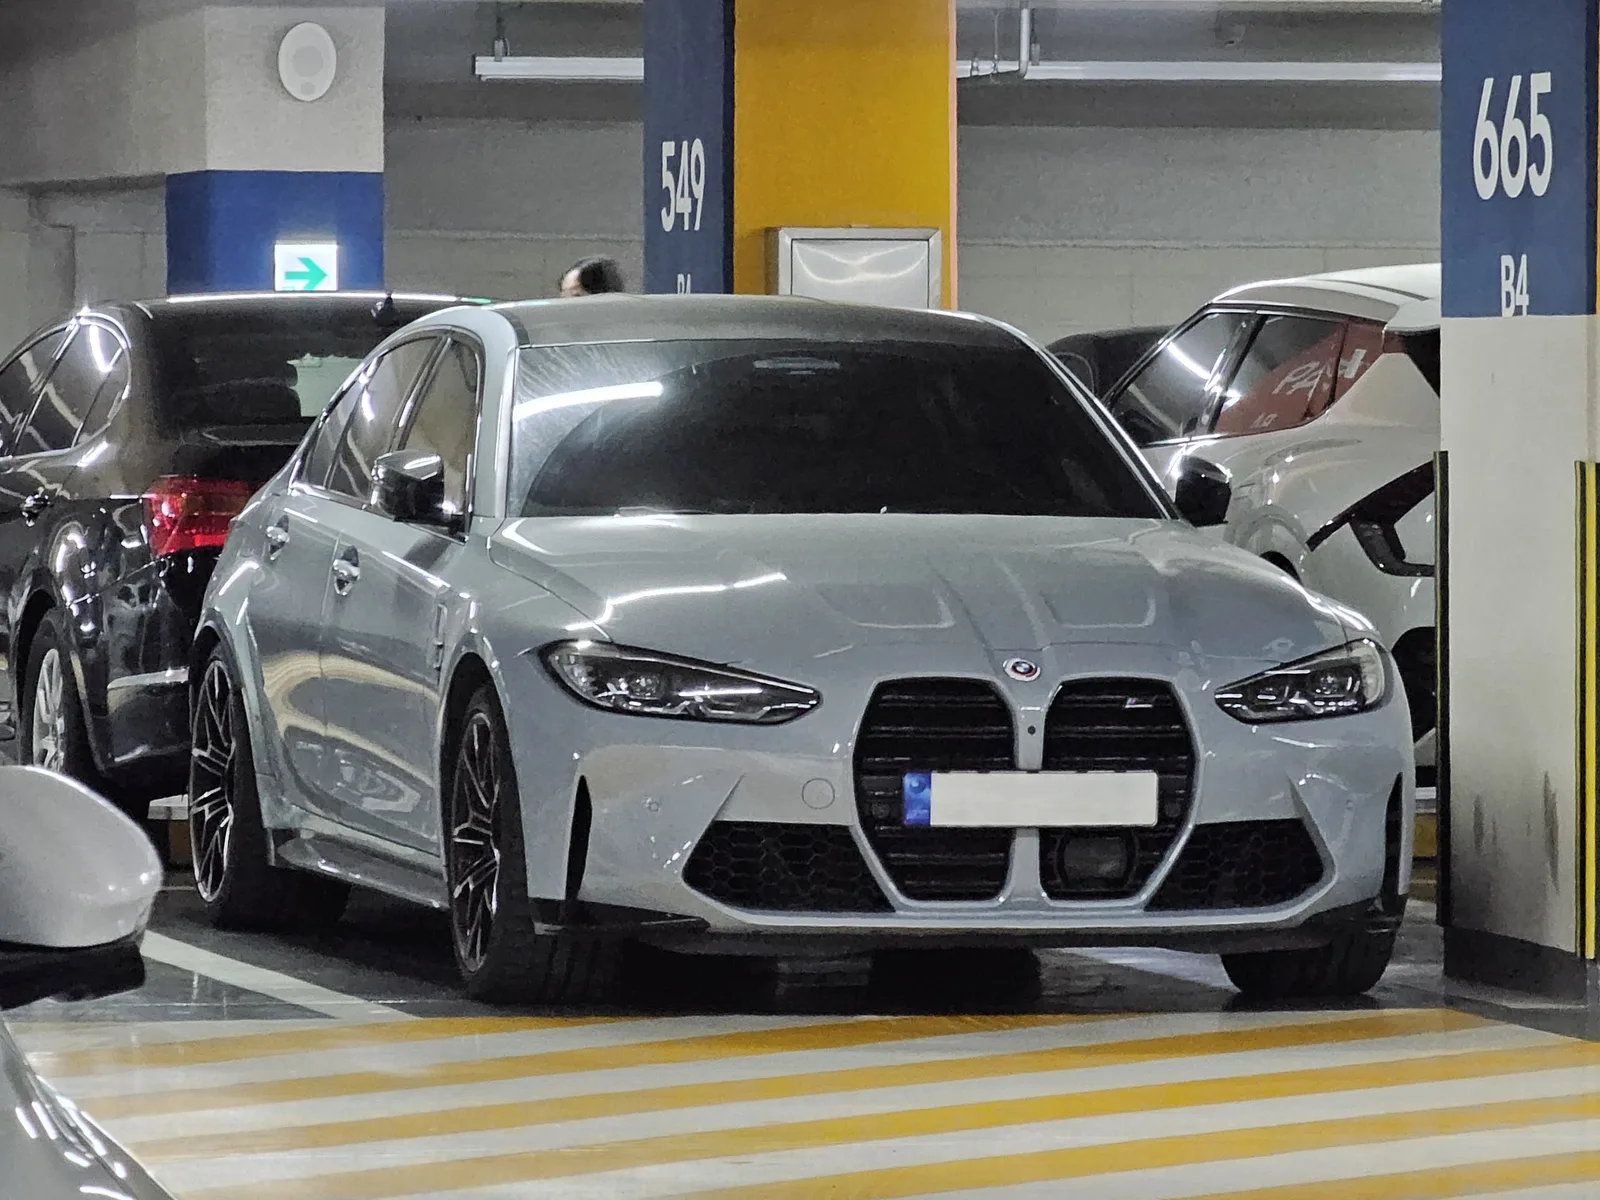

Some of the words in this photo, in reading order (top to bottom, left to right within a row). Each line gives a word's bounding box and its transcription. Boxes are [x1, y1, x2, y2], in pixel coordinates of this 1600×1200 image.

[1473, 72, 1553, 200] 665
[661, 138, 706, 232] 549
[1500, 253, 1529, 318] B4
